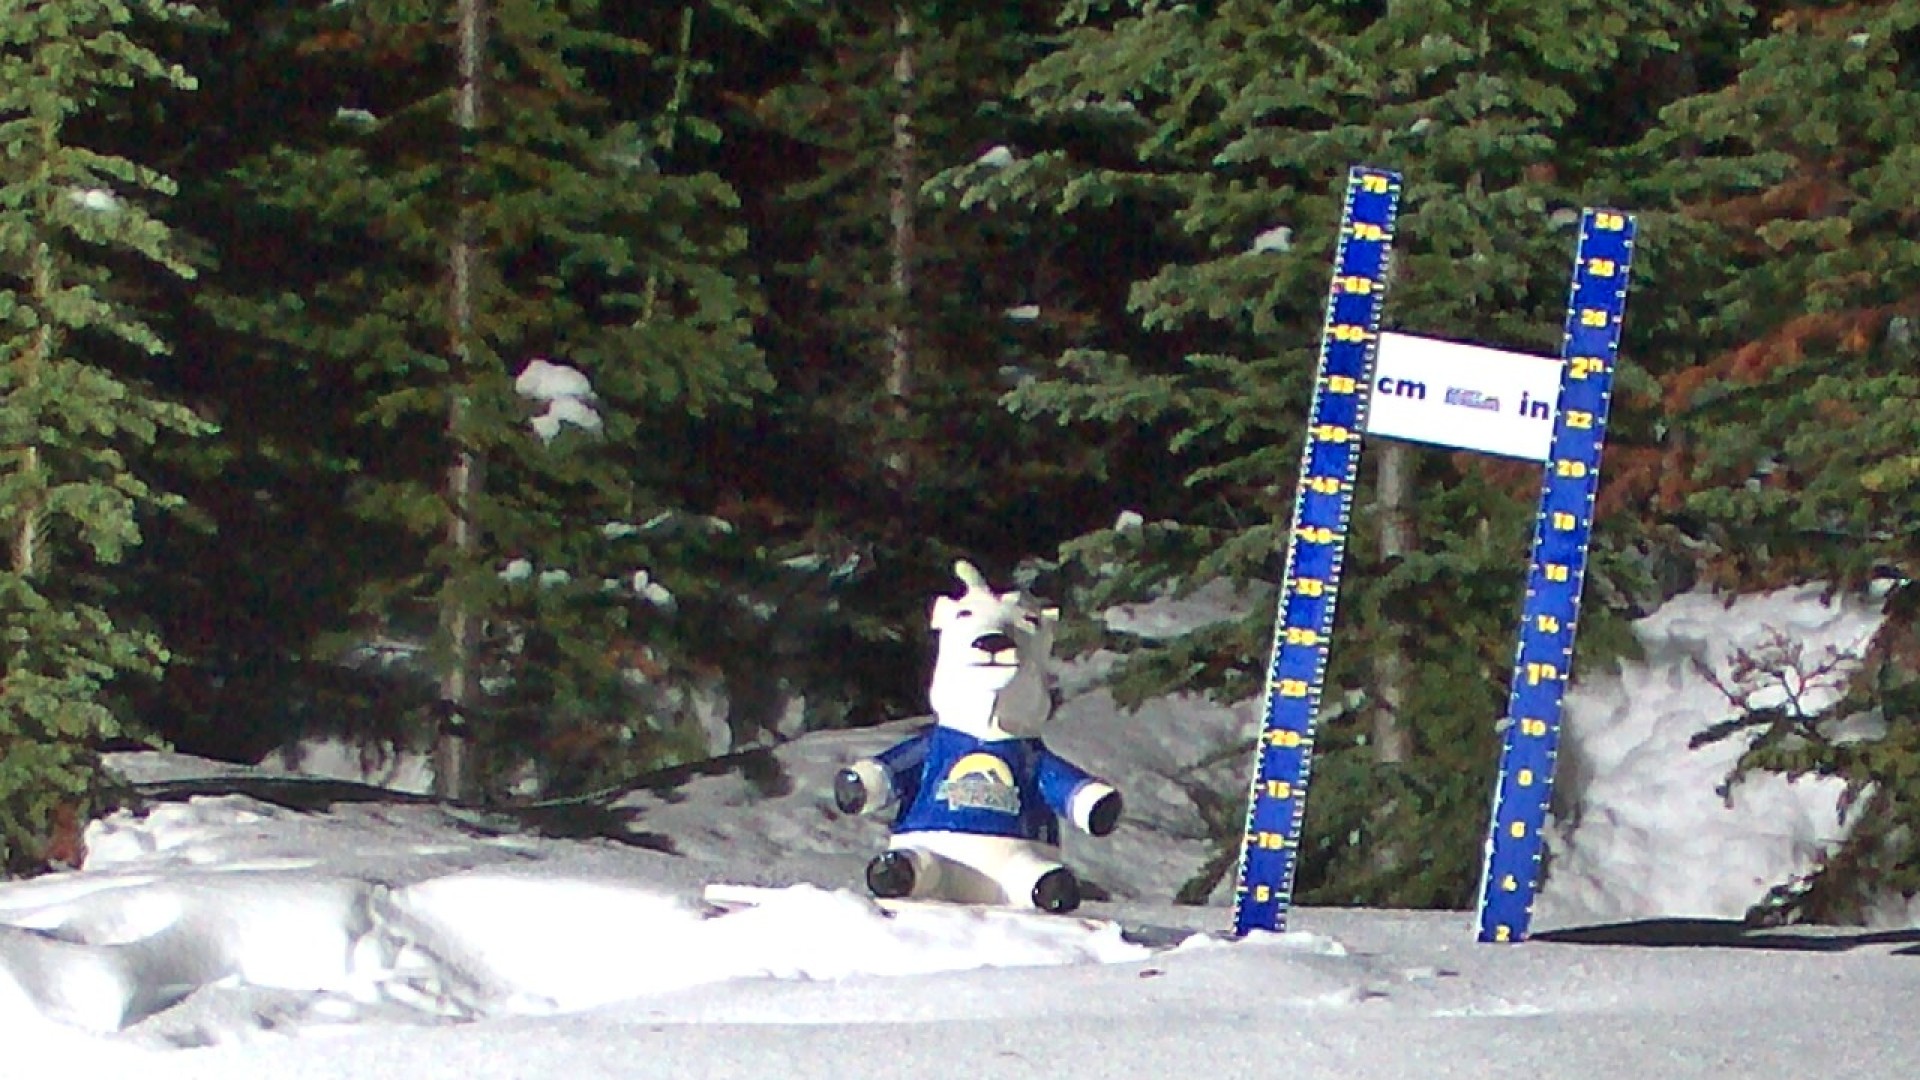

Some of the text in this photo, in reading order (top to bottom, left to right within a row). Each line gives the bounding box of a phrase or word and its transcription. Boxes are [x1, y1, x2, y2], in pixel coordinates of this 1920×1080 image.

[1378, 374, 1426, 400] cm
[1519, 390, 1550, 421] in
[1557, 459, 1585, 478] 20
[1538, 614, 1560, 634] 14
[1521, 717, 1546, 736] 10
[1267, 780, 1291, 799] 15
[1258, 831, 1284, 850] 10
[1501, 874, 1518, 892] 4
[1495, 924, 1511, 942] 2
